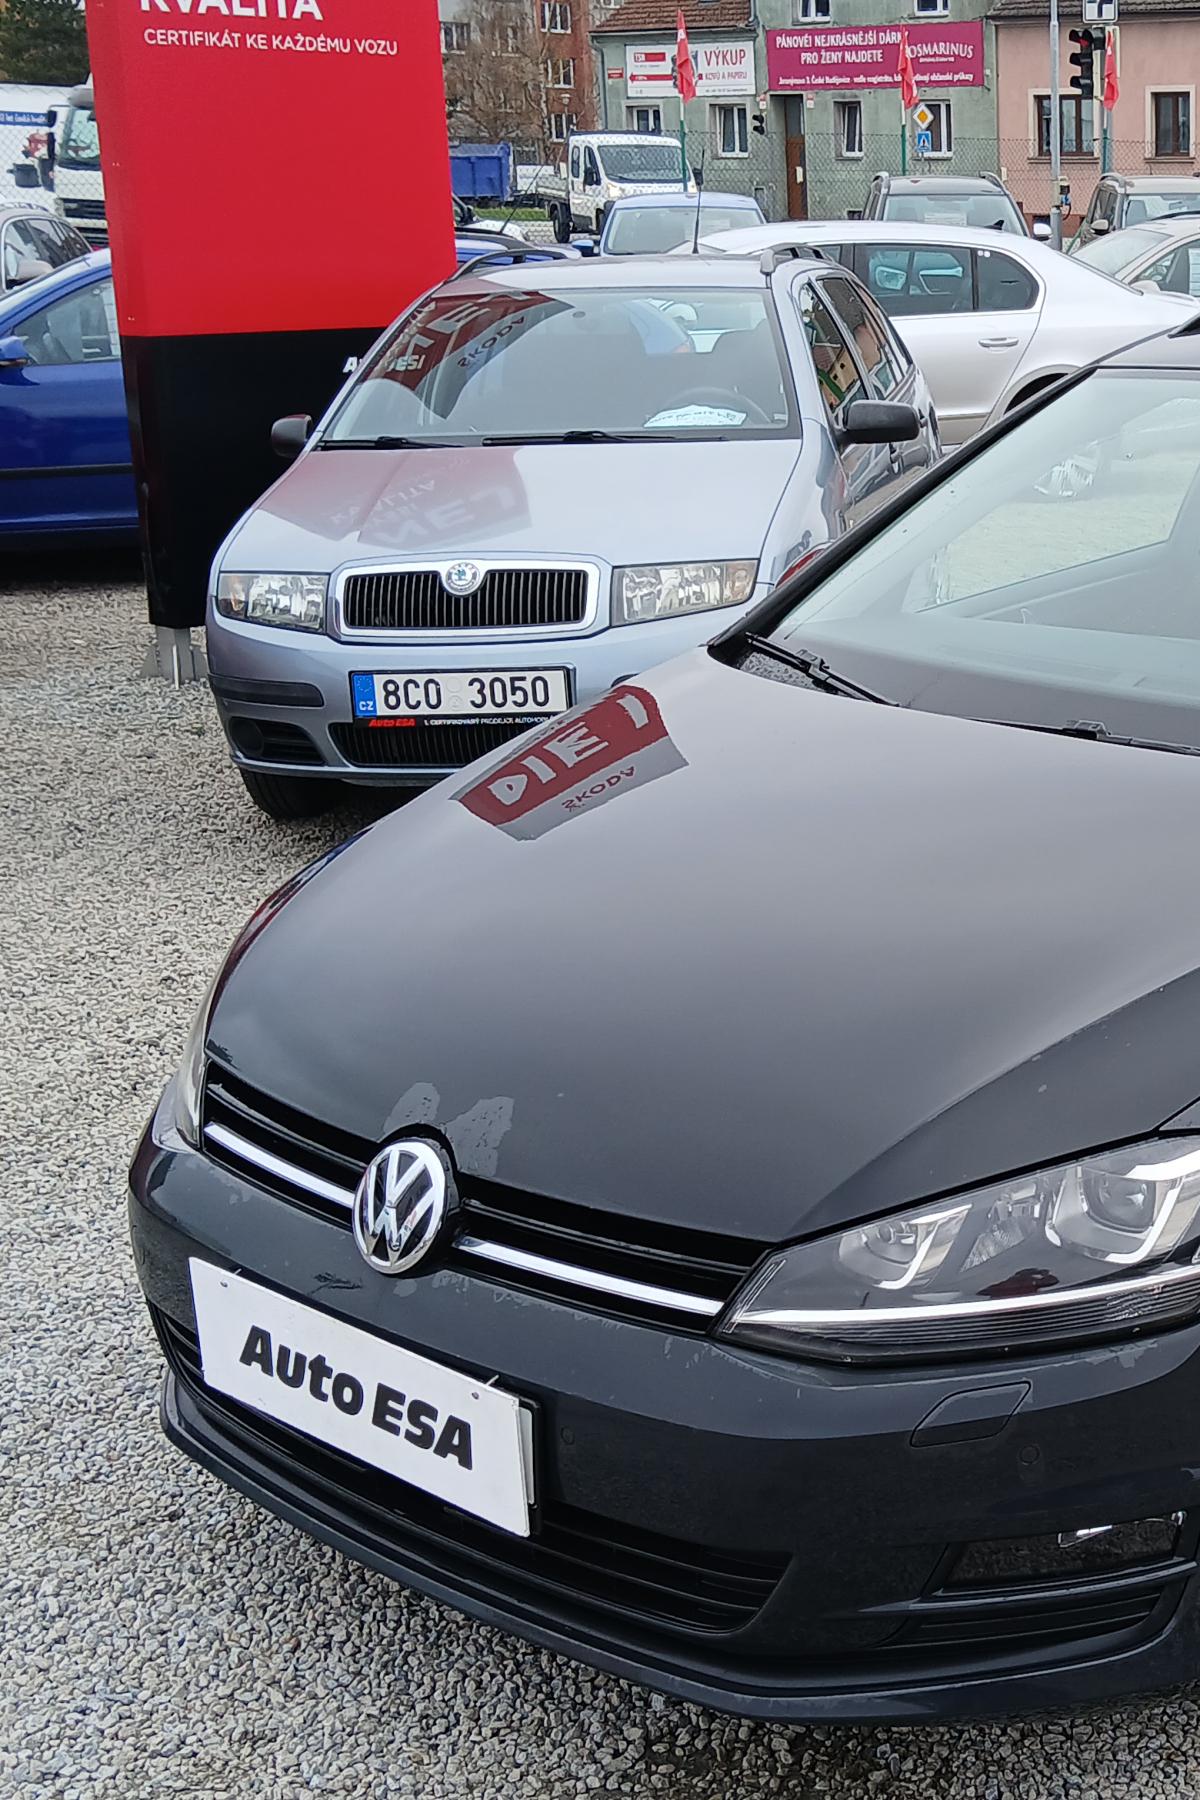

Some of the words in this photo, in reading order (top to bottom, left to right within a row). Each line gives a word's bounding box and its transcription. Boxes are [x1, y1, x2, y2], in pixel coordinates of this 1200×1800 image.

[143, 28, 240, 48] CERTIFIKÁT
[246, 33, 268, 50] KE
[271, 32, 351, 54] KAŽDÉMU
[354, 38, 398, 56] VOZU
[814, 30, 877, 47] NEJKRÁSNĚJŠÍ
[704, 46, 746, 67] VÝKUP
[801, 52, 819, 64] PRO
[821, 49, 842, 64] ŽENY
[845, 50, 883, 63] NAJDETE
[906, 42, 974, 59] OSMARINUS
[382, 678, 442, 711] 8C0
[468, 676, 550, 709] 3050
[359, 701, 374, 711] CZ
[239, 1325, 364, 1416] Auto
[372, 1382, 473, 1471] ESA
